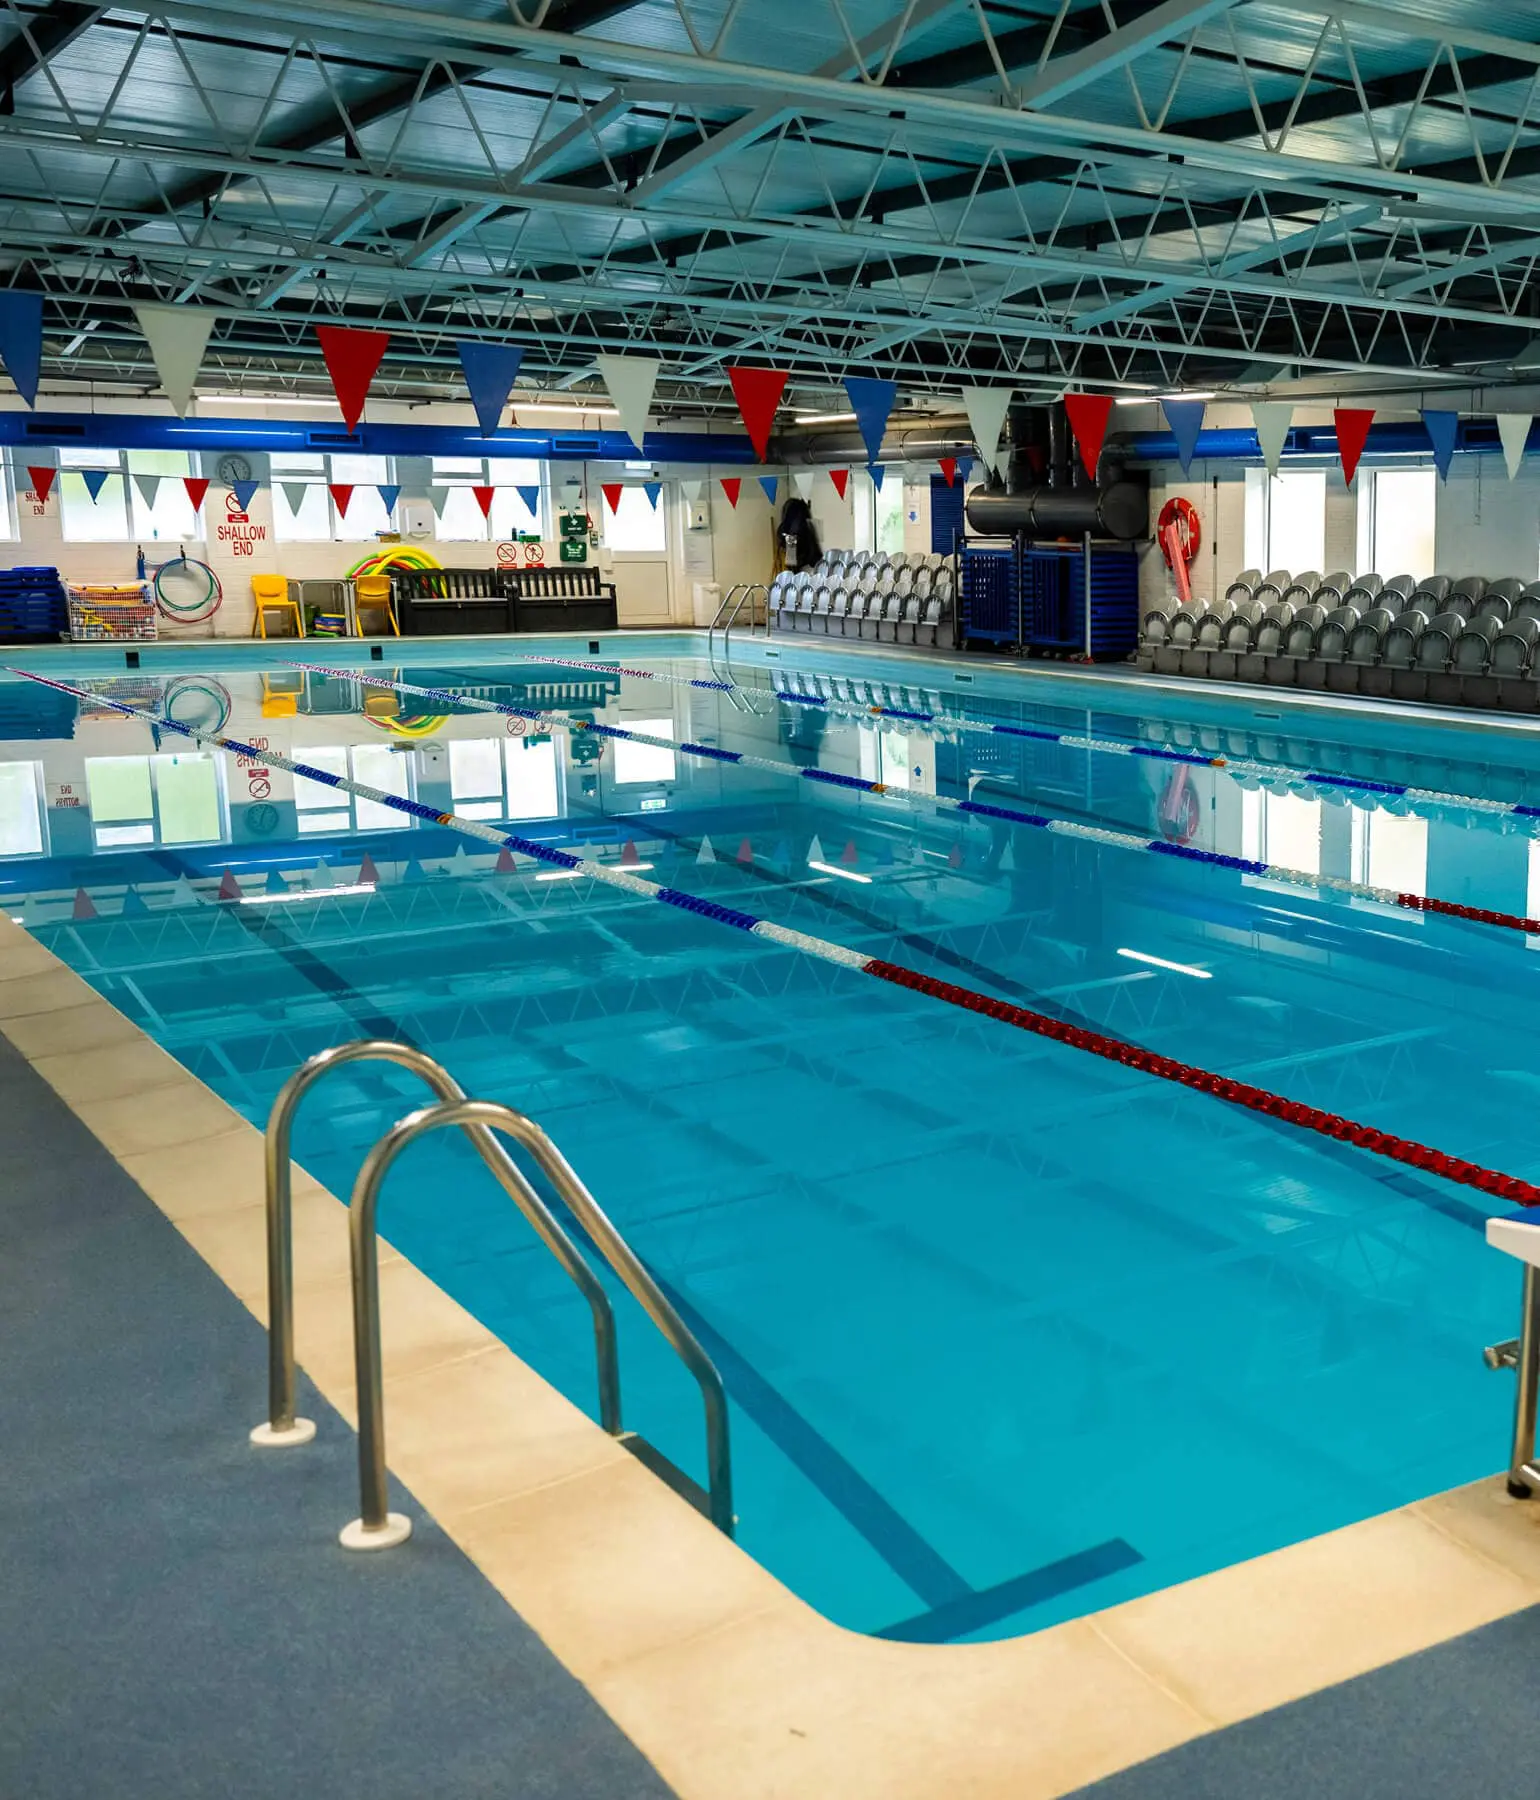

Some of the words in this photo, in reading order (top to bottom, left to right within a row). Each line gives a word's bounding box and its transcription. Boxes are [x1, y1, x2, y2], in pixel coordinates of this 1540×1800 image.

[33, 505, 45, 516] END
[217, 526, 266, 540] SHALLOW
[233, 541, 253, 556] END
